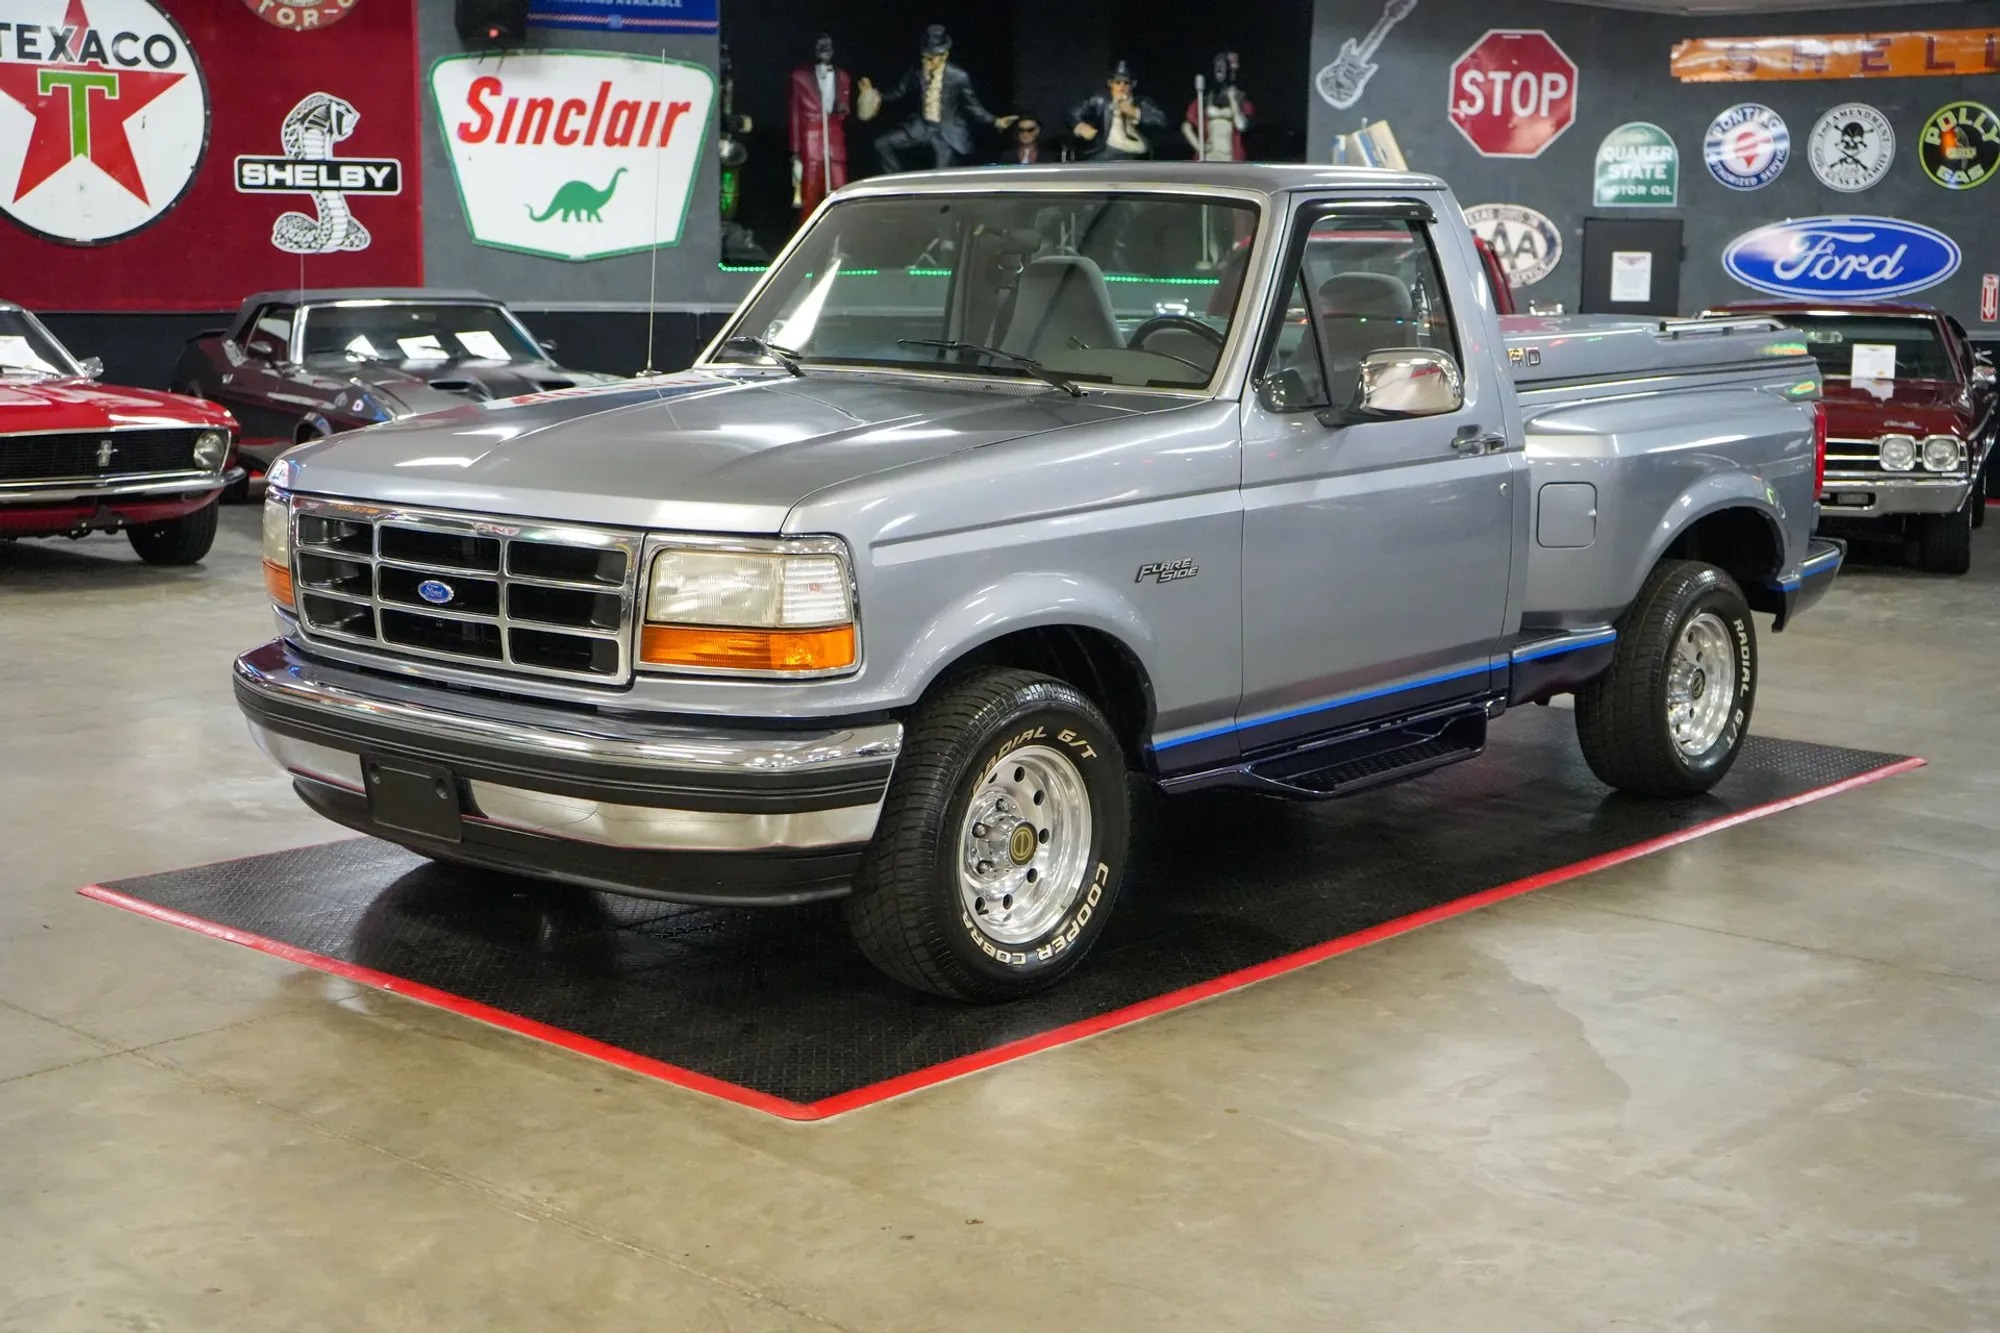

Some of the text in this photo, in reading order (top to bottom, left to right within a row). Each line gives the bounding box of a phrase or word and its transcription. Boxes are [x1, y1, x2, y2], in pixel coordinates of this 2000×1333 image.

[1725, 33, 2000, 74] SHELL
[1458, 69, 1568, 118] STOP
[457, 76, 692, 149] Sinclair
[1709, 106, 1781, 137] PONTIAC
[1832, 109, 1891, 142] AMENDMENT
[1925, 107, 2000, 146] POLLY
[1602, 145, 1674, 163] QUAKER
[1760, 146, 1787, 182] SERVIC
[242, 162, 392, 189] SHELBY
[1608, 163, 1667, 180] STATE
[1936, 165, 1985, 184] GAS
[1650, 184, 1673, 196] OIL
[1470, 221, 1539, 270] AA
[1773, 230, 1908, 281] Ford
[1135, 557, 1192, 583] FLARE
[1157, 566, 1199, 584] SIDE
[1727, 619, 1751, 750] RADIAL G/T
[1057, 729, 1098, 760] G/T
[962, 862, 1109, 965] COOPER COBRA
